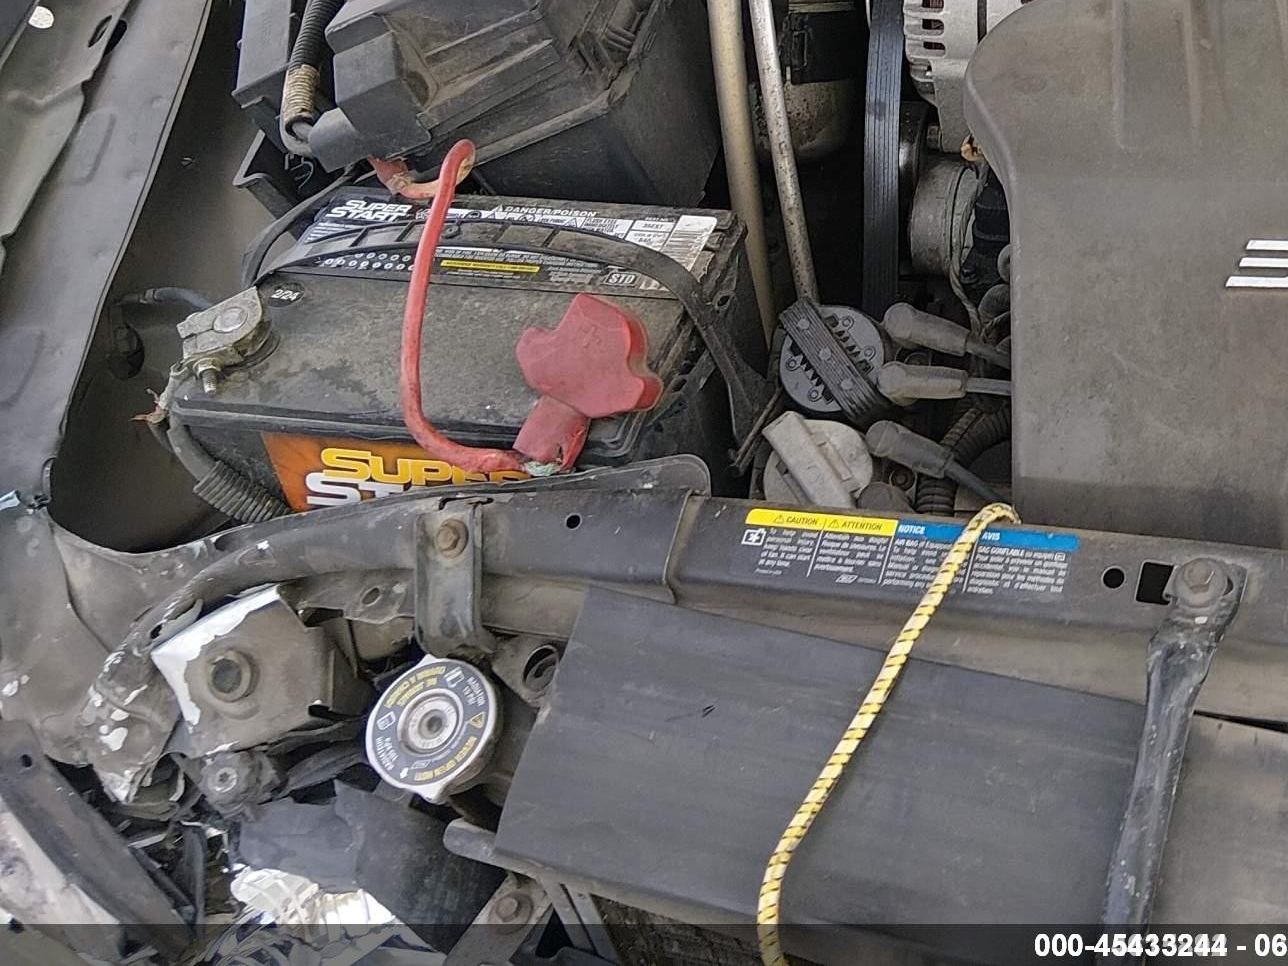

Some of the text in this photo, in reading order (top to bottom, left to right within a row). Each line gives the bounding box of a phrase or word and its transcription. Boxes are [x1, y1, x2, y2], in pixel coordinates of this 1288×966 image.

[345, 199, 413, 213] SUPER
[504, 205, 597, 217] DANGER/POISON
[325, 206, 406, 222] START
[608, 273, 636, 284] STD
[785, 516, 818, 526] CAUTION
[841, 521, 883, 531] ATTENTION
[898, 524, 926, 535] NOTICE
[981, 531, 1001, 542] AVIS
